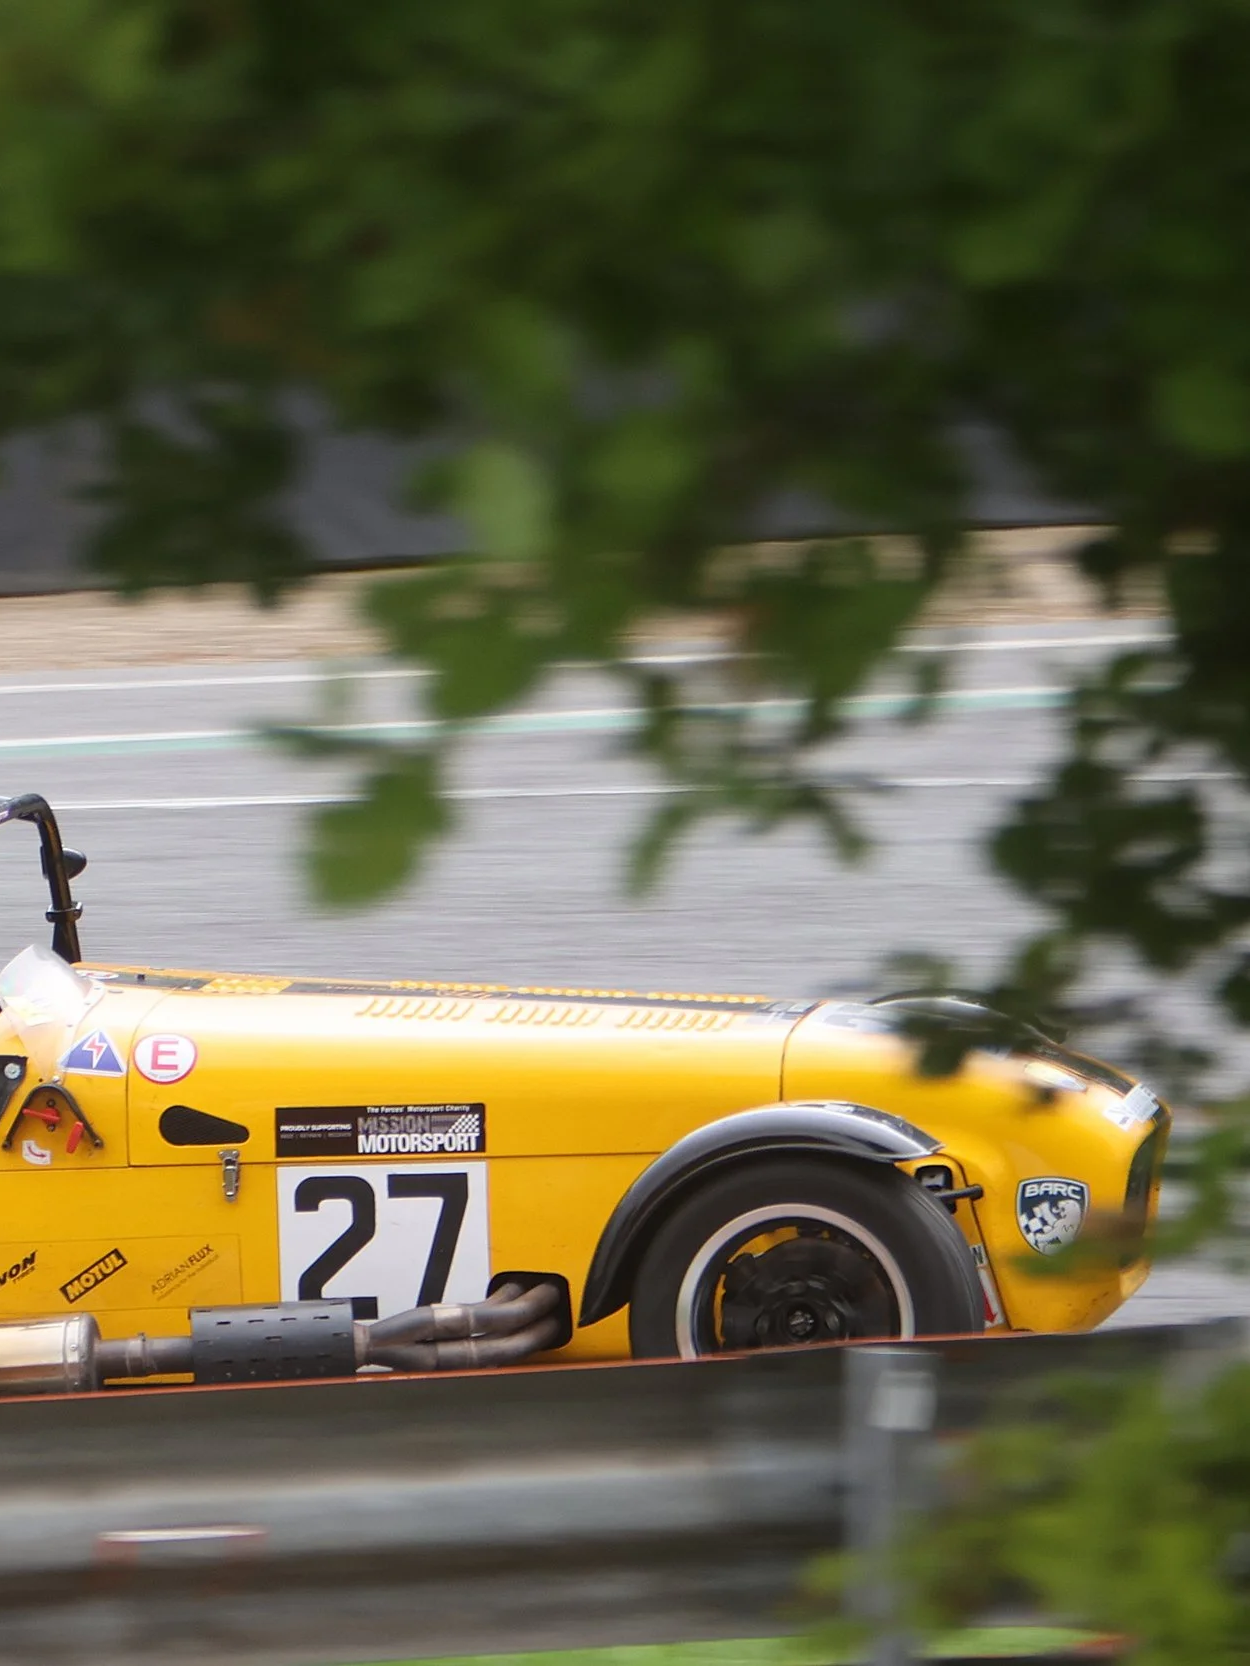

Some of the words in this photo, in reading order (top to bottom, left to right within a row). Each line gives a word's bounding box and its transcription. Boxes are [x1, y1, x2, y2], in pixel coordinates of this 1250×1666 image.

[151, 1040, 179, 1070] E
[367, 1106, 379, 1114] The
[407, 1105, 444, 1114] Motorsport
[445, 1104, 470, 1113] Charity
[310, 1123, 352, 1131] SUPPORTING
[358, 1115, 430, 1134] MISSION
[357, 1132, 480, 1153] MOTORSPORT
[1024, 1182, 1082, 1200] BARC
[294, 1172, 469, 1319] 27
[65, 1253, 125, 1300] MOTUL
